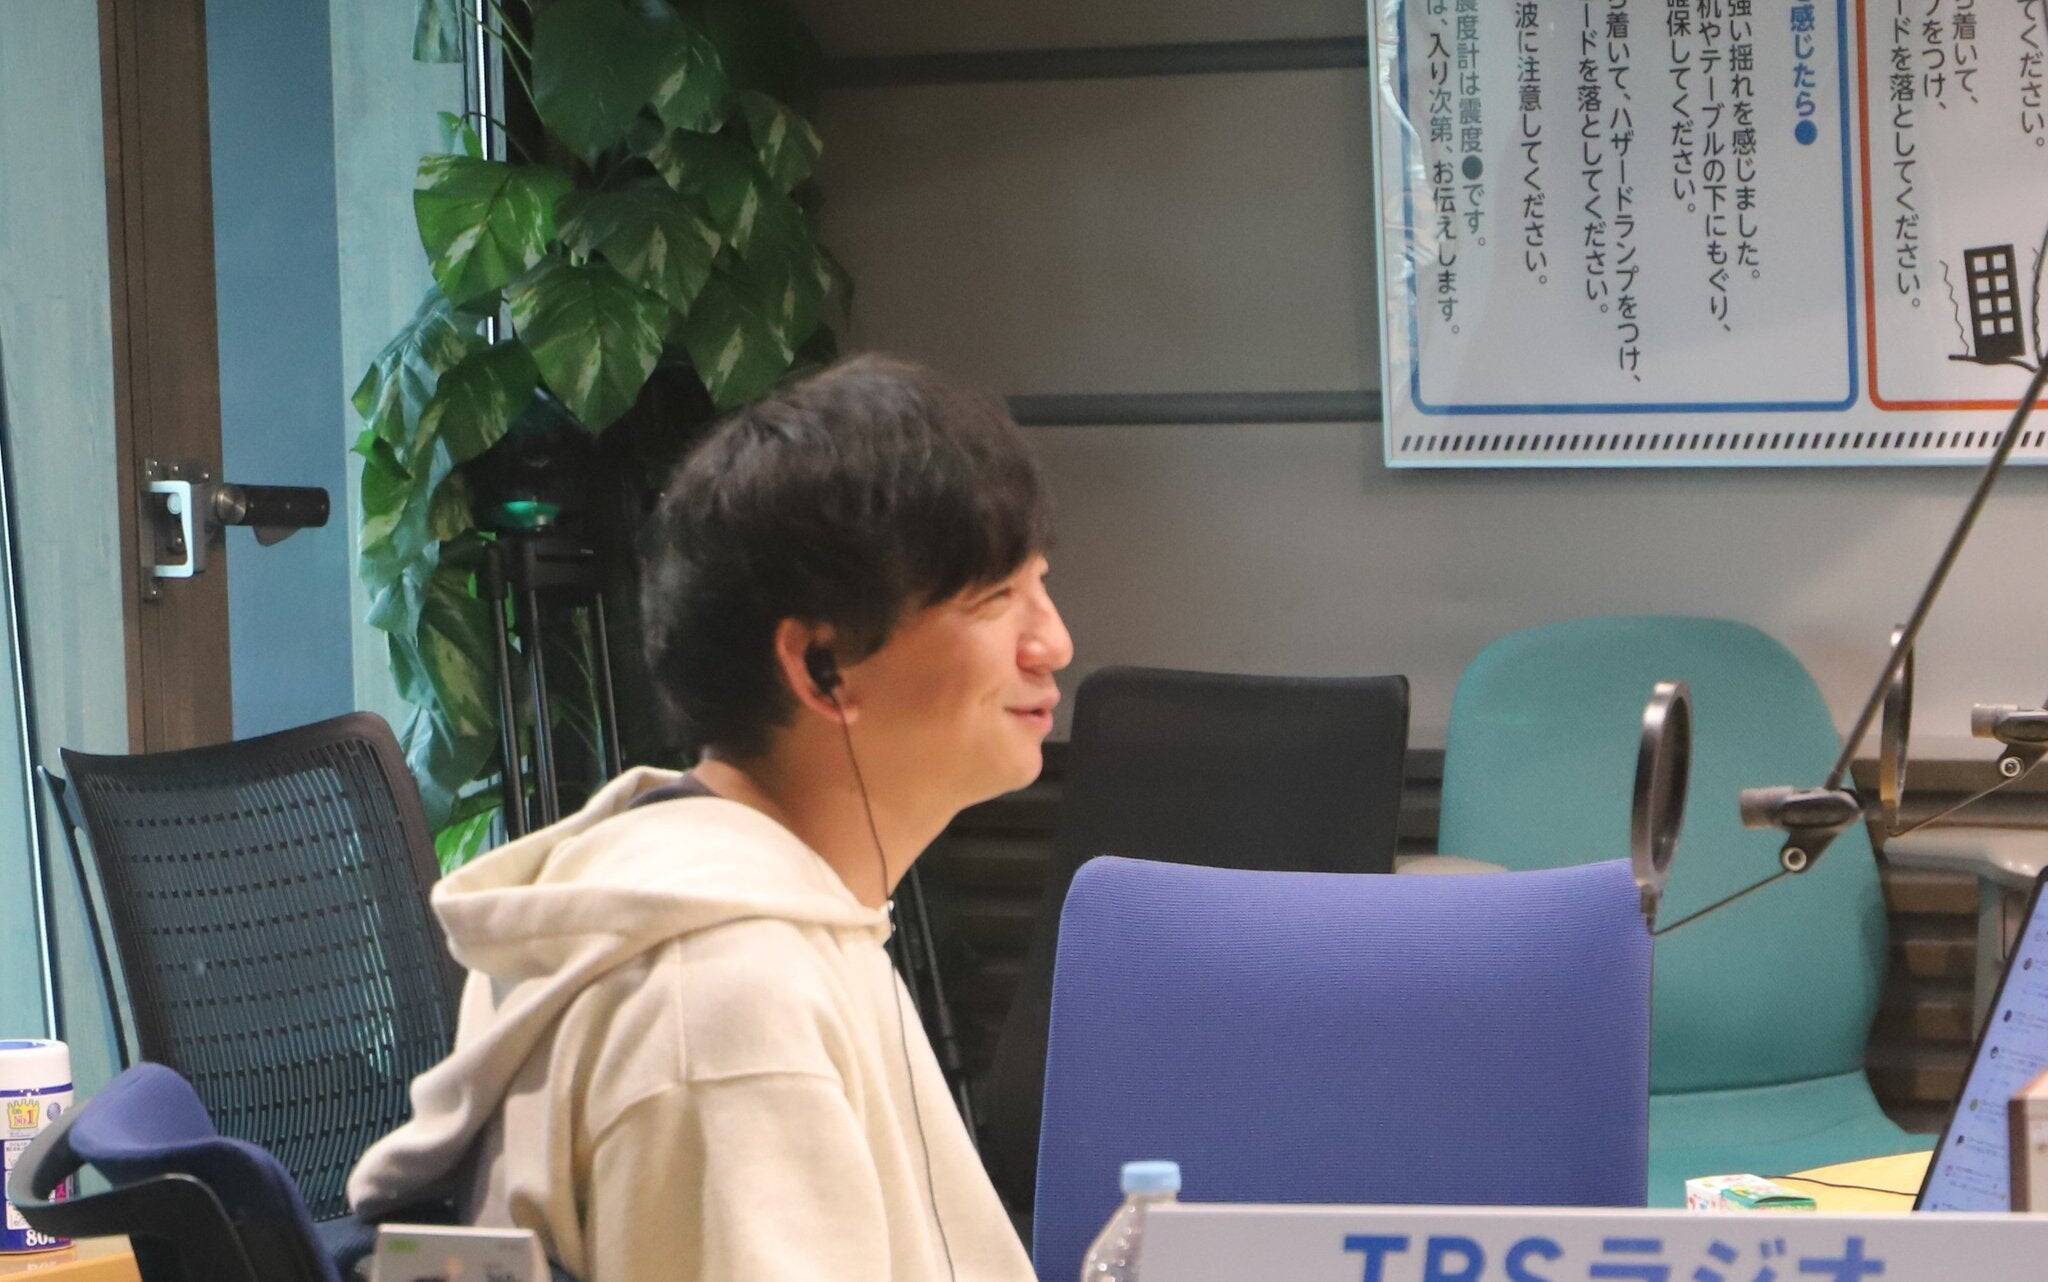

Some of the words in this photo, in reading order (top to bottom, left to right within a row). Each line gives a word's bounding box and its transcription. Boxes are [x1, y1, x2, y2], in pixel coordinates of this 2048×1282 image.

[1515, 2, 1548, 285] 波に注意してください。
[1666, 0, 1696, 213] 保してください。
[1697, 0, 1731, 332] 机やテーブルの下にもぐり、
[1728, 0, 1760, 279] 強い揺れを感じました。
[2016, 0, 2045, 147] てください。
